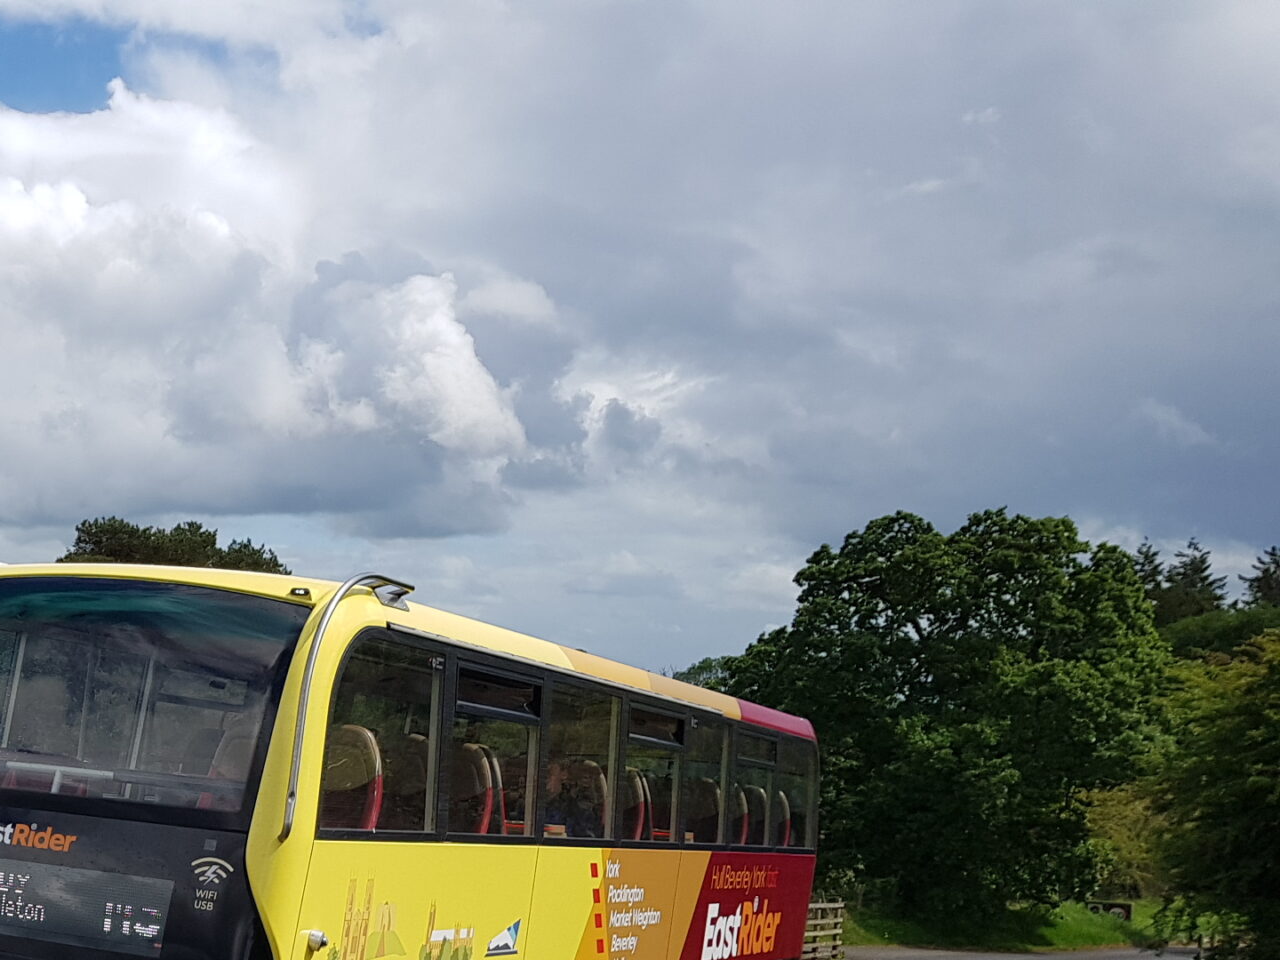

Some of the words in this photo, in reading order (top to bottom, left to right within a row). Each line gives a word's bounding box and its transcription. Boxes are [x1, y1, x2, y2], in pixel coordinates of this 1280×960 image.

[606, 859, 621, 878] York
[710, 864, 725, 890] Hull
[724, 864, 752, 896] Beverley
[751, 864, 768, 889] York
[195, 888, 218, 900] WIFI
[607, 883, 645, 907] Pocklington
[194, 900, 215, 911] USB
[609, 908, 632, 928] Market
[632, 906, 661, 930] Weighton
[611, 932, 638, 954] Beverley
